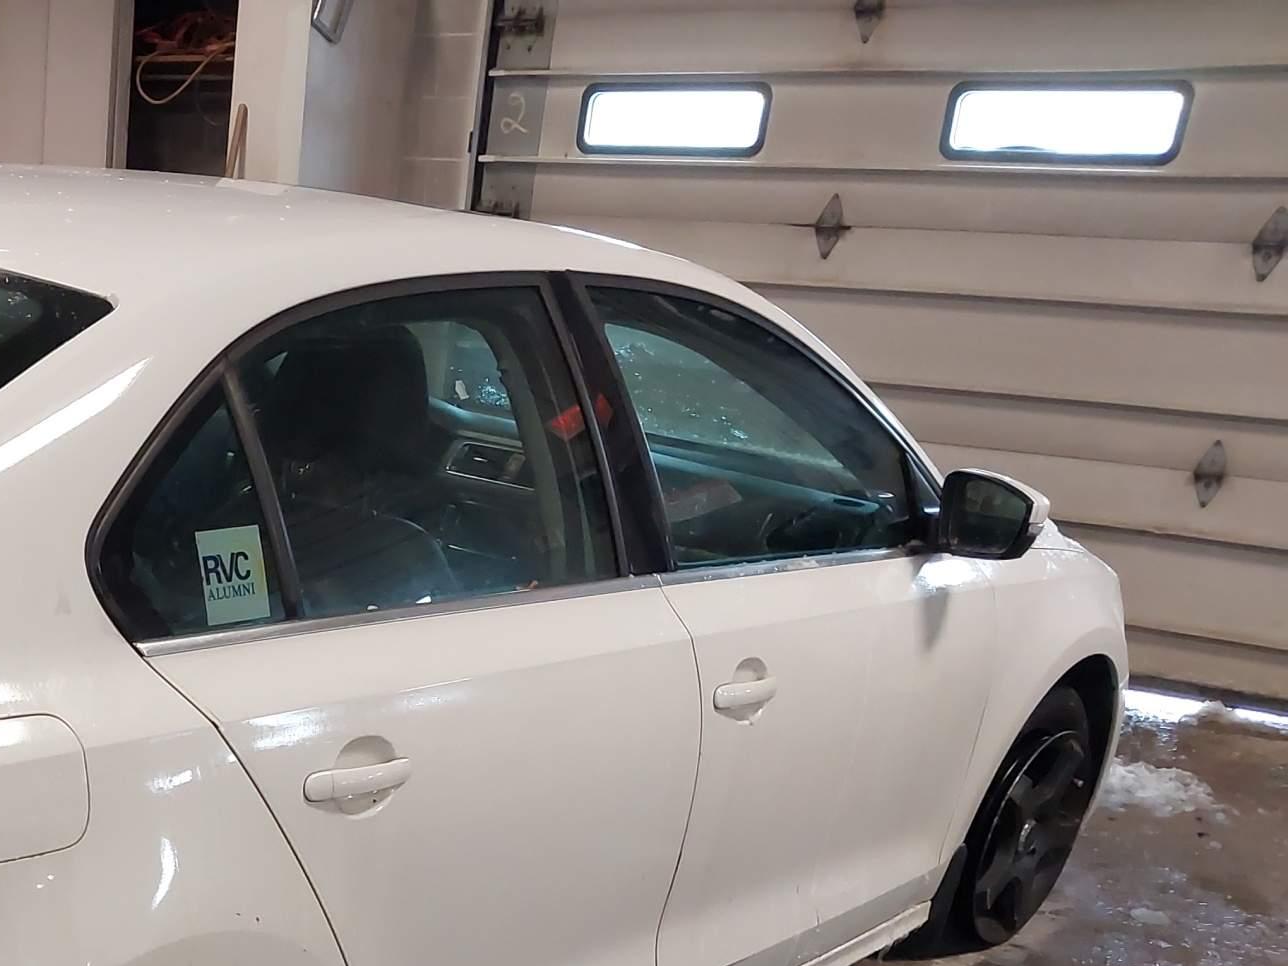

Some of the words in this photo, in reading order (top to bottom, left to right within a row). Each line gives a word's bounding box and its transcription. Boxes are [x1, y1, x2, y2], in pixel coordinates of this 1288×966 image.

[500, 92, 529, 134] 2
[201, 551, 252, 586] RVC
[207, 582, 256, 602] ALUMNI
